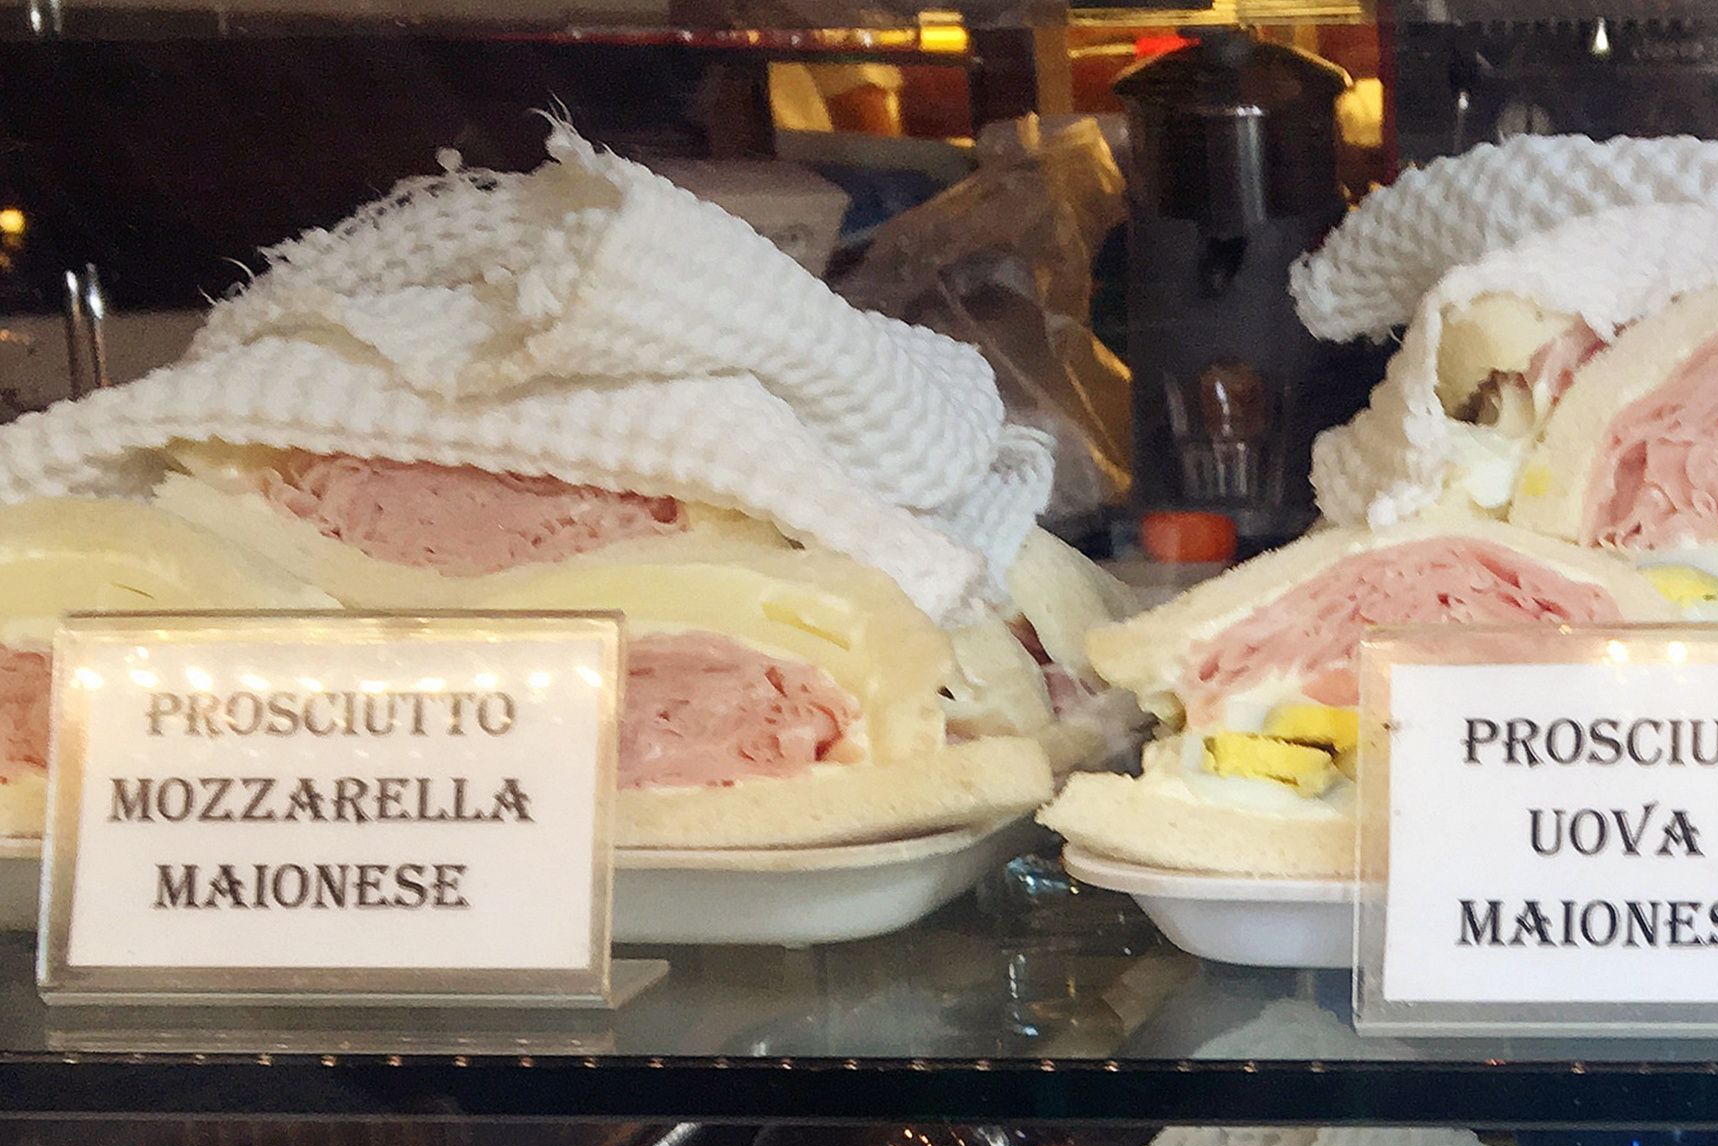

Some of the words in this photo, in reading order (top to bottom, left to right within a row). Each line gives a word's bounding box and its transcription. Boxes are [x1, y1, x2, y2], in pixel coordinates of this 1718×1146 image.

[145, 691, 516, 738] PROSCIUTTO
[110, 777, 535, 824] MOZZARELLA
[1528, 802, 1705, 857] UOVA
[153, 863, 470, 910] MAIONESE
